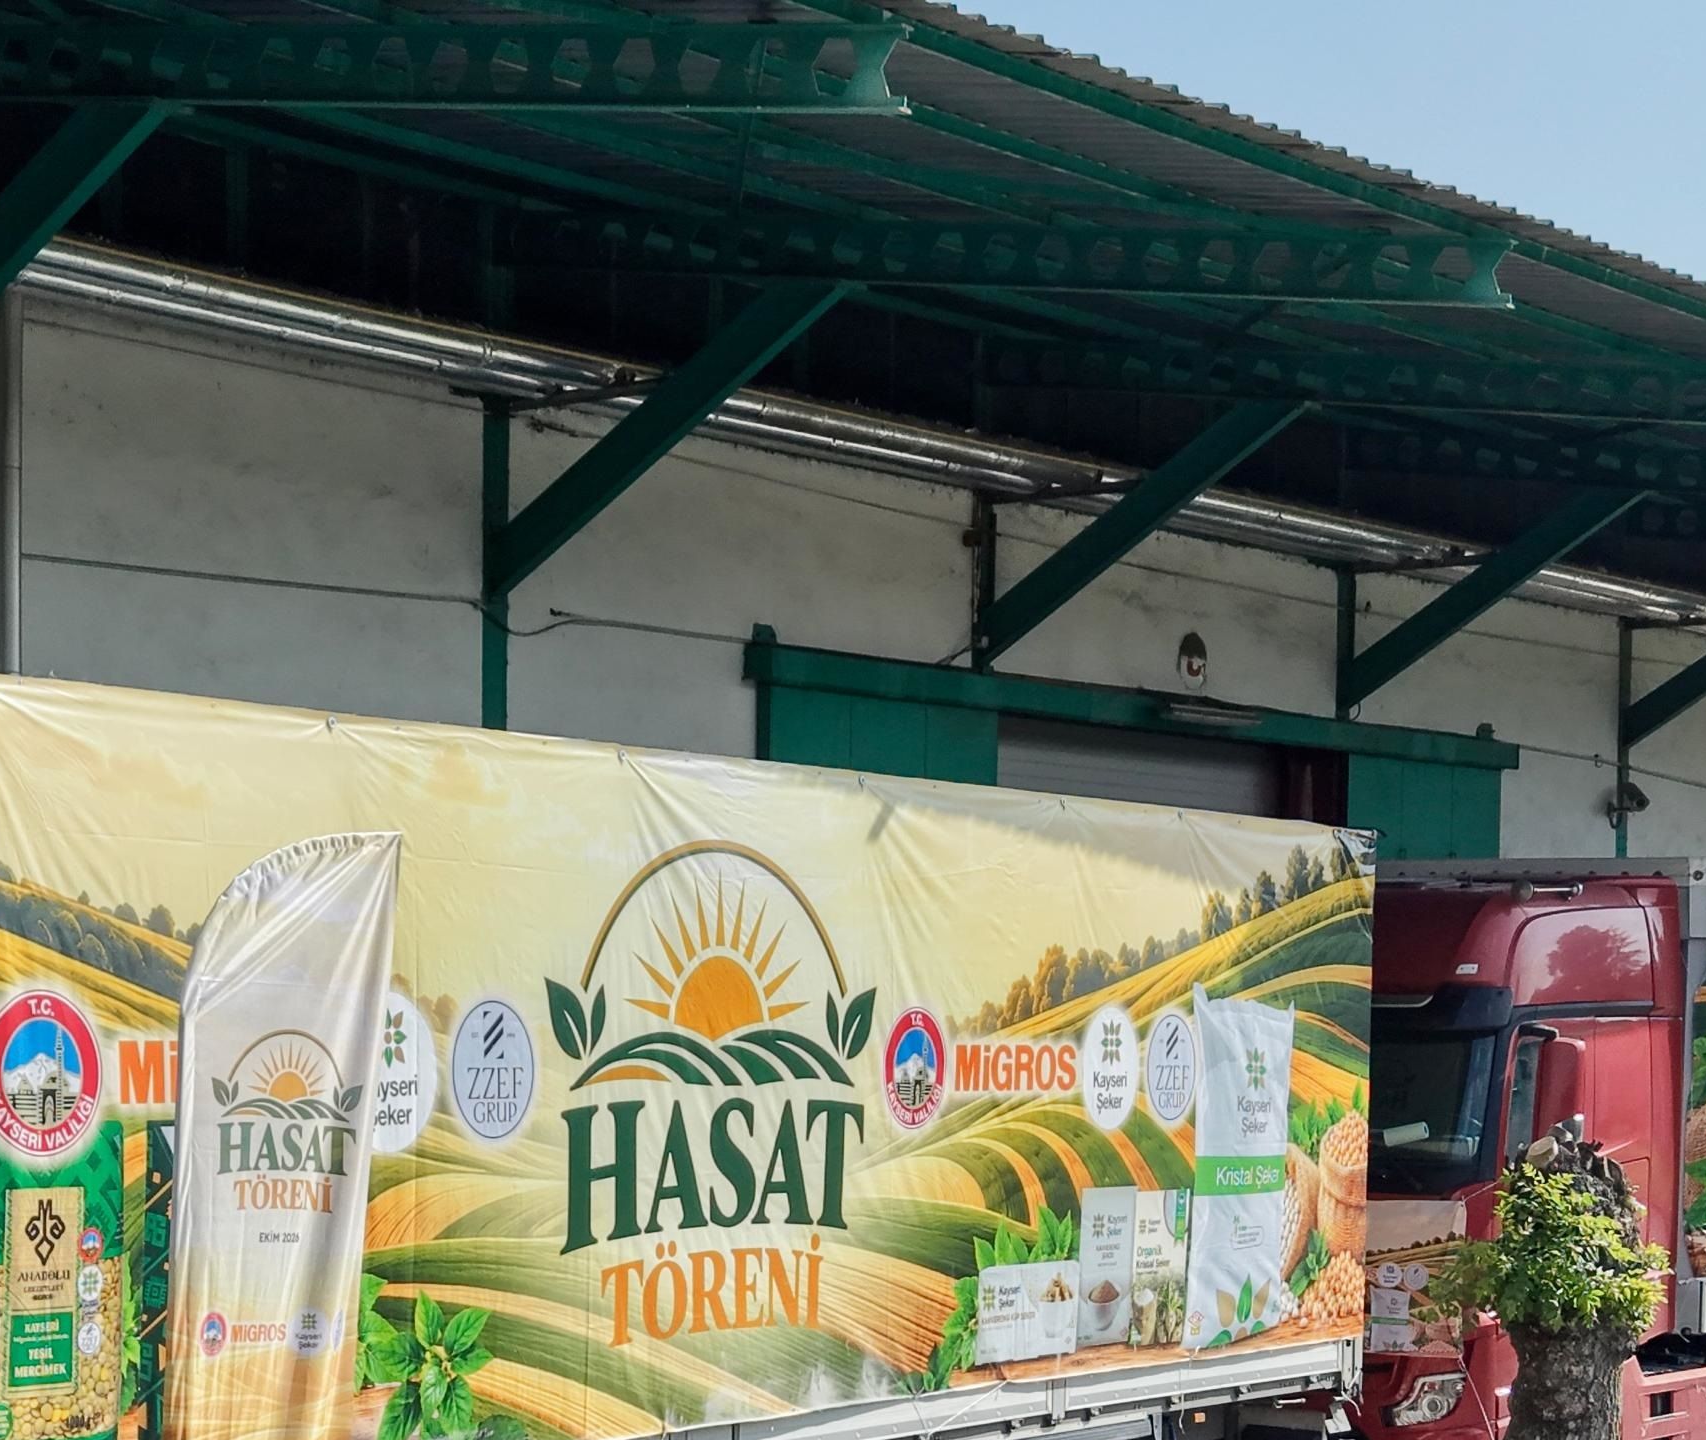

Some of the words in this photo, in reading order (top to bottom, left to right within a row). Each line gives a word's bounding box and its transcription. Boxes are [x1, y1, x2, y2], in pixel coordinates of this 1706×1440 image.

[27, 998, 55, 1017] T.C.
[377, 1074, 418, 1102] yseri
[467, 1067, 524, 1099] ZZEF
[1093, 1071, 1128, 1091] Kayseri
[1155, 1065, 1189, 1091] ZZEF
[473, 1101, 518, 1123] GRUP
[1096, 1093, 1124, 1115] Şeker
[1157, 1092, 1186, 1109] GRUP
[1237, 1095, 1272, 1115] Kayseri
[45, 1093, 95, 1150] VALİLİĞİ
[373, 1108, 412, 1131] eker
[1241, 1117, 1268, 1137] Şeker
[217, 1121, 357, 1177] HASAT
[559, 1097, 864, 1256] HASAT
[1216, 1166, 1253, 1187] Kristal
[1255, 1166, 1281, 1189] Şeker
[233, 1174, 334, 1214] TÖRENİ
[259, 1230, 280, 1243] EKİM
[601, 1232, 824, 1348] TÖRENİ
